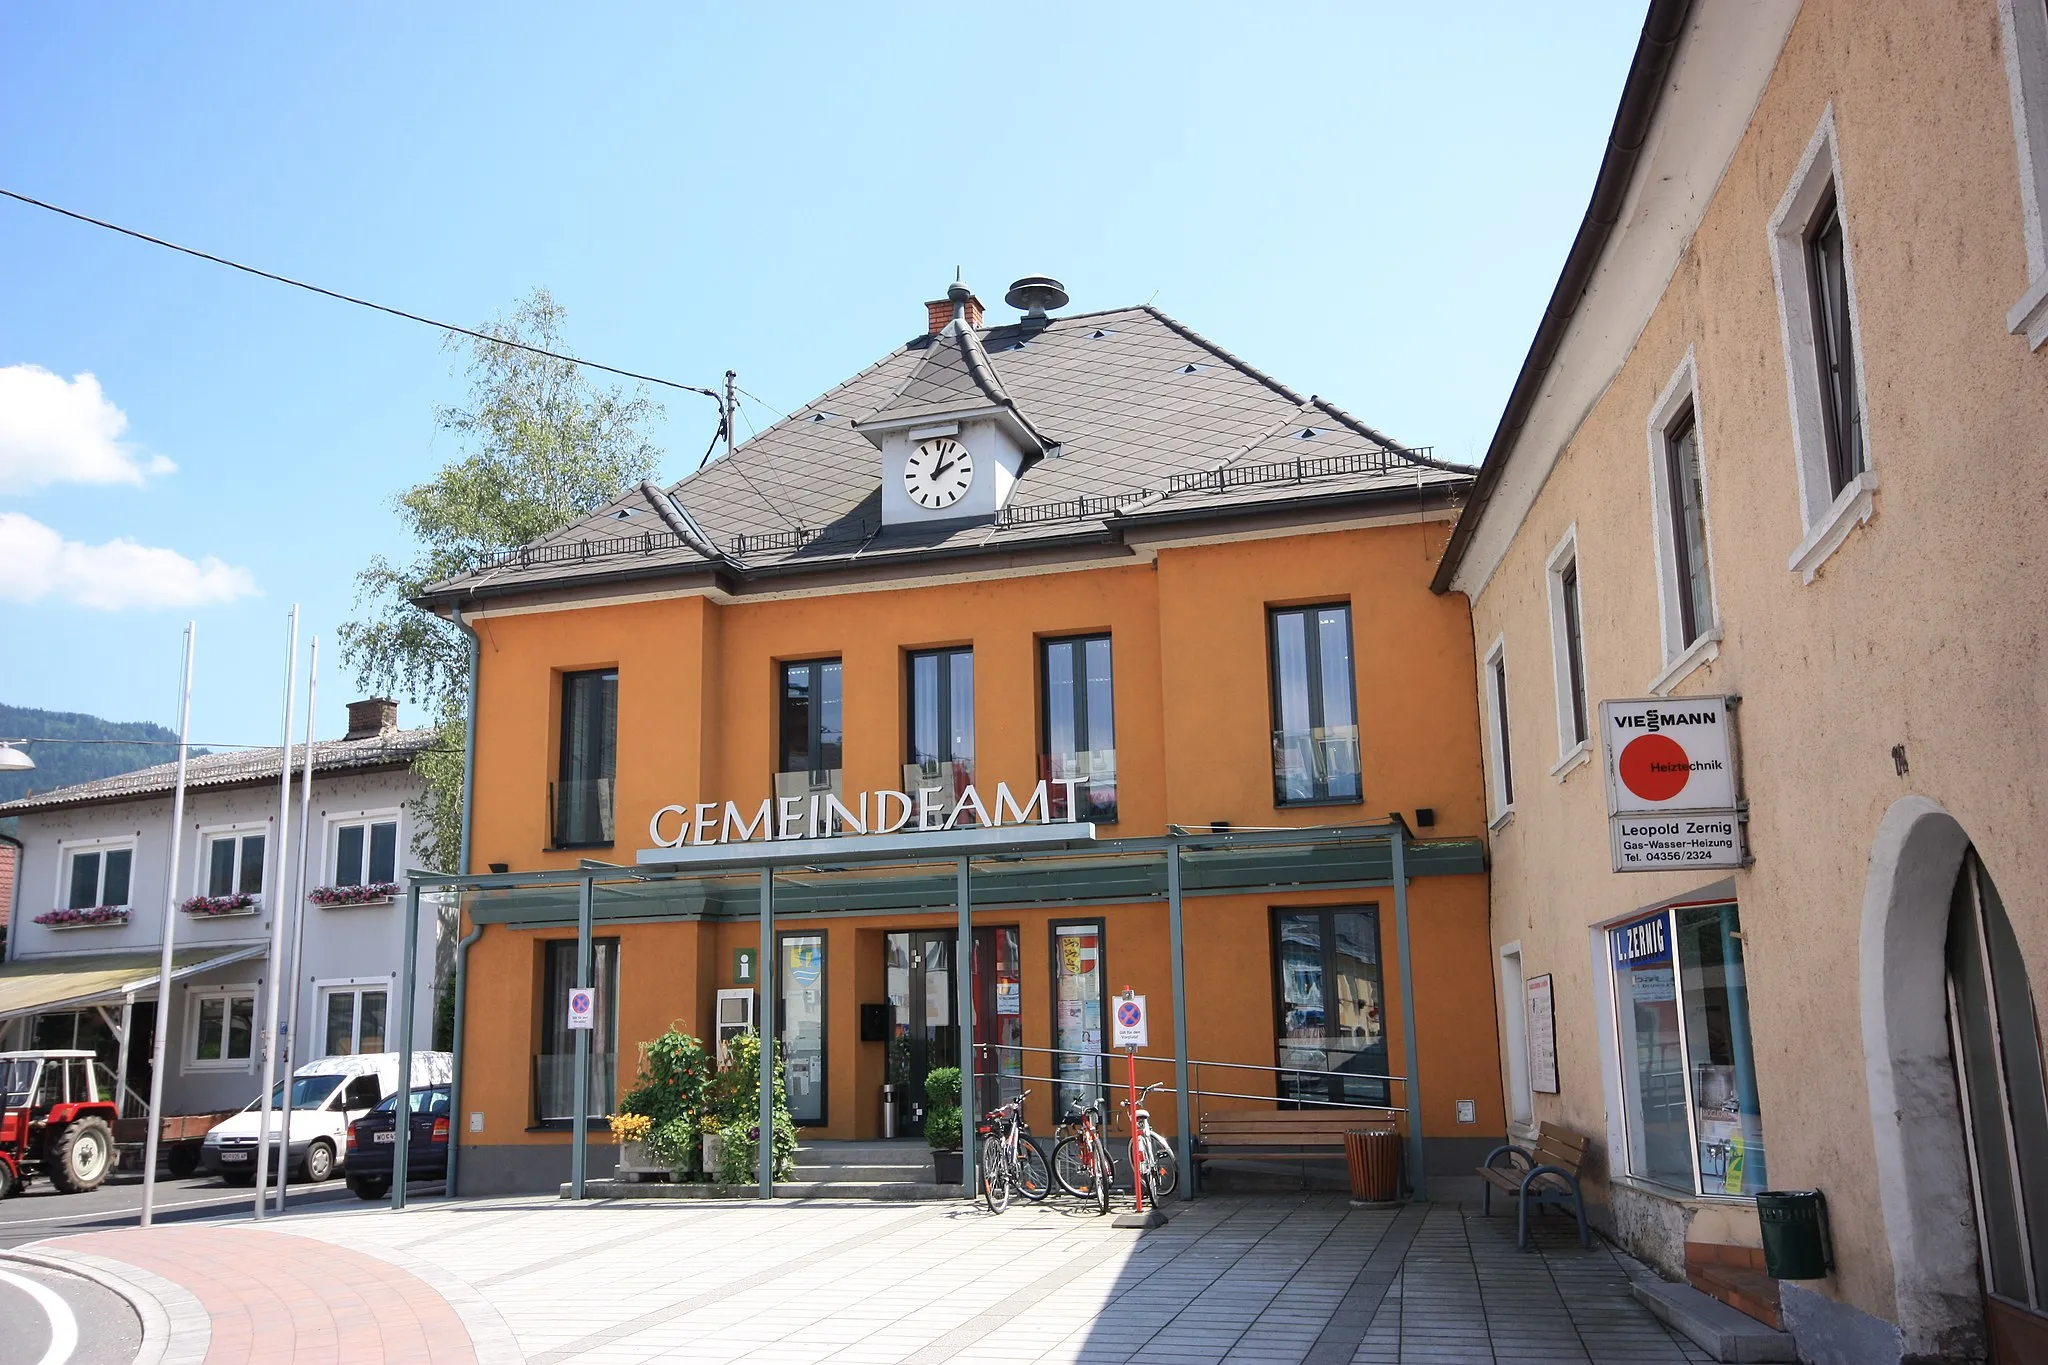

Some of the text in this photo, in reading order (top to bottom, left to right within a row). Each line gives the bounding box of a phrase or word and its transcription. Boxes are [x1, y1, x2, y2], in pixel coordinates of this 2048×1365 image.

[1614, 709, 1717, 732] VIESSMANN
[1650, 760, 1723, 773] Heiztechnik
[649, 775, 1090, 848] GEMEINDEAMT
[1622, 821, 1732, 837] Leopold Zernig
[1623, 838, 1733, 850] Gas-Wasser-Heizung
[1625, 850, 1713, 862] Tel. 04356/2324
[1616, 918, 1665, 961] L. ZERNIG
